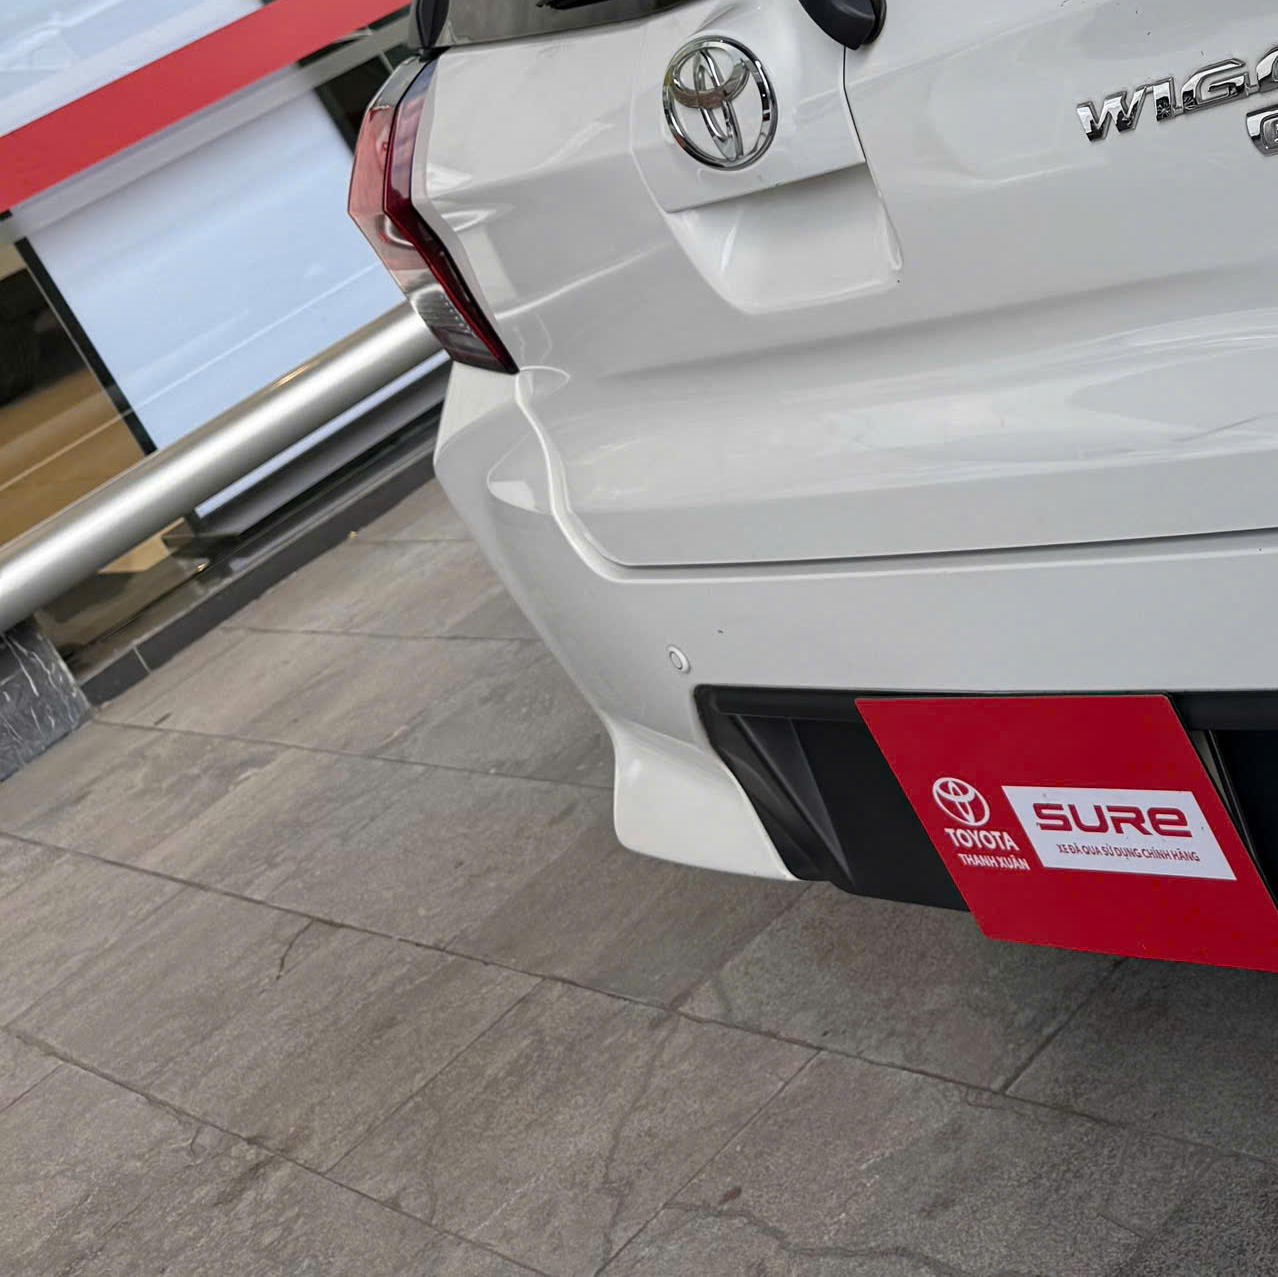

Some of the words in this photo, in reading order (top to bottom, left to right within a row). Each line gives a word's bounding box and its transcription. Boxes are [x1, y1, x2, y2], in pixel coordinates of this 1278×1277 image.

[944, 828, 1020, 850] TOYOTA
[1056, 843, 1070, 854] XE
[1082, 845, 1103, 856] QUA
[1113, 846, 1142, 860] DỤNG
[1142, 846, 1173, 860] CHÍNH
[957, 853, 999, 867] THANH
[998, 854, 1031, 870] XUÂN
